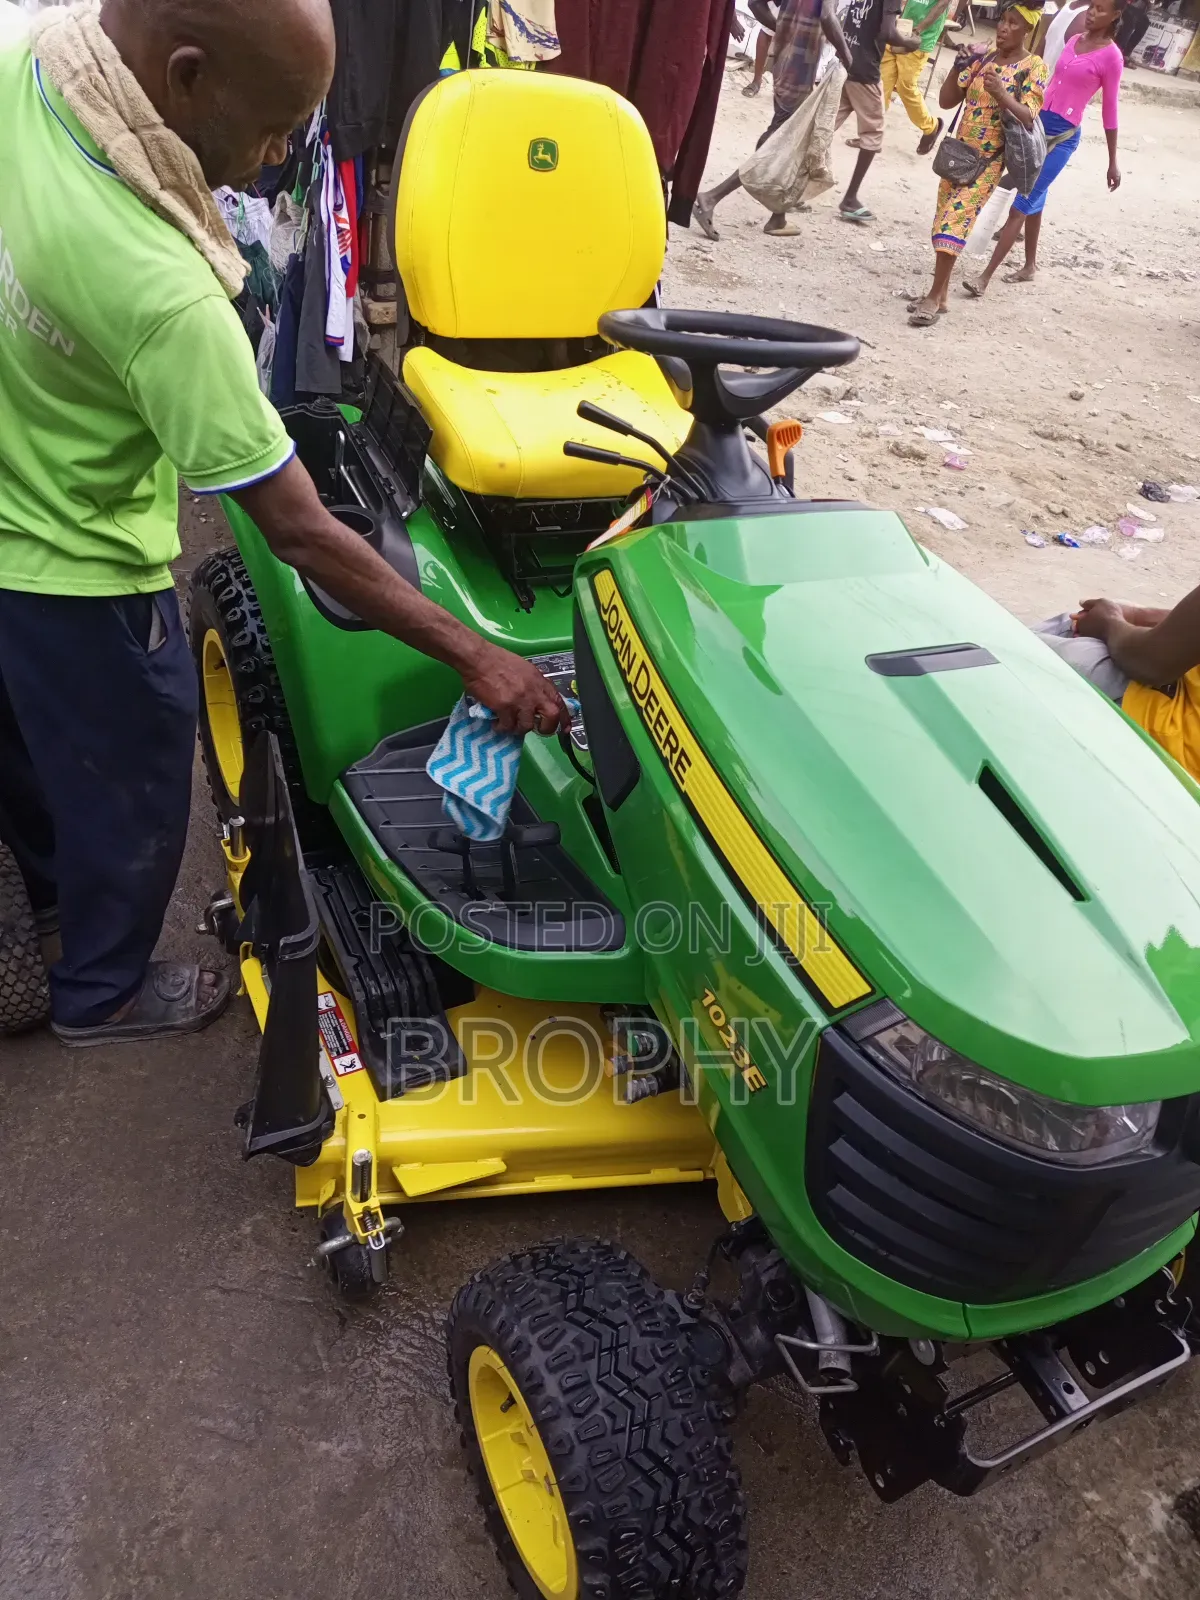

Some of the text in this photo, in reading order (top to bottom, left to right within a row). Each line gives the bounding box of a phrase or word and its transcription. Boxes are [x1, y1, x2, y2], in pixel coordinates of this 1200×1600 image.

[0, 225, 75, 357] RDEN
[601, 590, 637, 677] JOHN
[633, 659, 692, 786] DEERE
[702, 988, 767, 1092] 1023E
